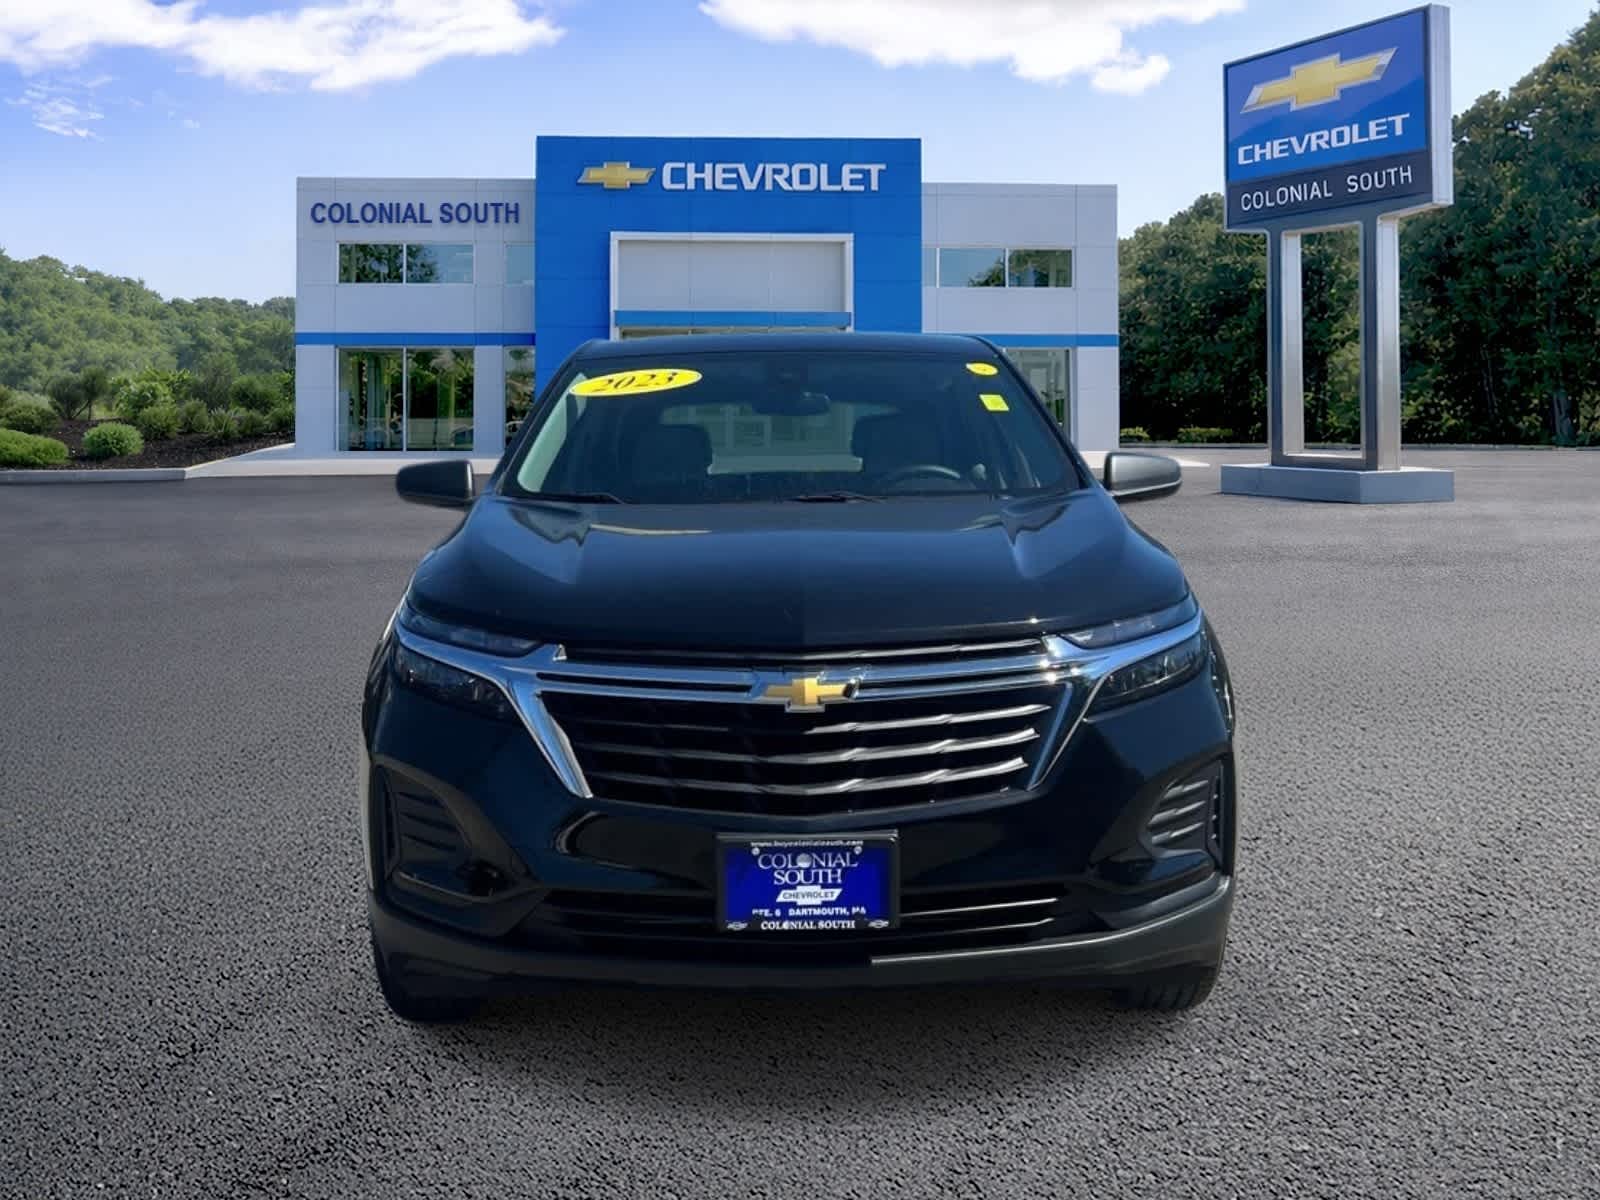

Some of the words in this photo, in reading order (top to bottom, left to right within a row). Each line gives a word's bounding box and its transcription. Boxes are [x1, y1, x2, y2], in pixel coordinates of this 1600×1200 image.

[1237, 113, 1410, 165] CHEVROLET
[662, 162, 887, 192] CHEVROLET
[1241, 179, 1333, 211] COLONIAL
[1346, 165, 1413, 193] SOUTH
[310, 202, 433, 224] COLONIAL
[439, 202, 520, 224] SOUTH
[591, 371, 678, 393] 2023
[757, 852, 858, 869] COLONIAL
[773, 868, 843, 885] SOUTH
[782, 890, 836, 900] CHEVROLET
[760, 920, 817, 930] COLONIAL
[818, 919, 856, 930] SOUTH
